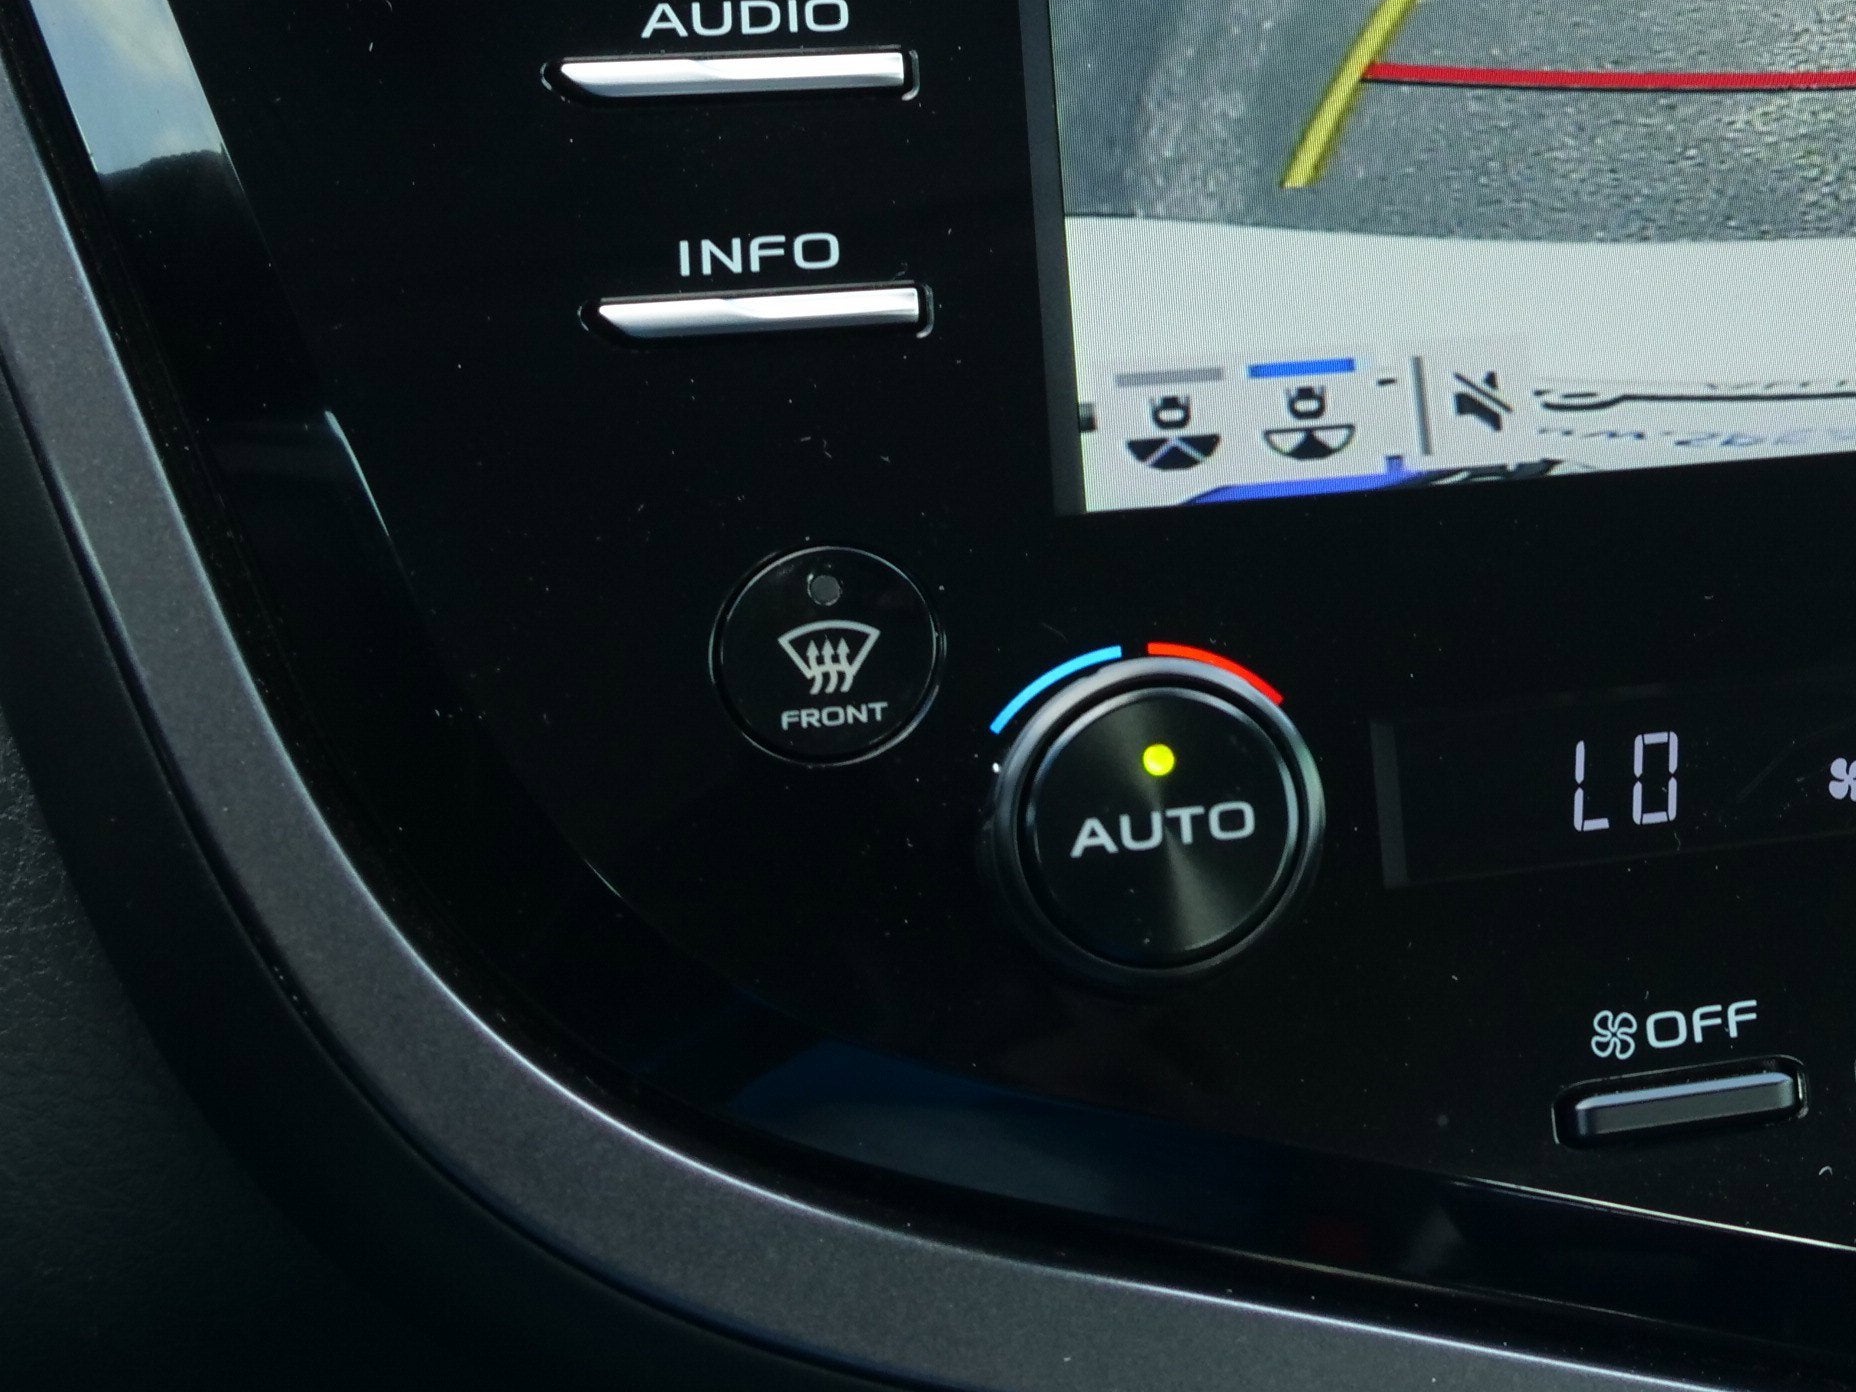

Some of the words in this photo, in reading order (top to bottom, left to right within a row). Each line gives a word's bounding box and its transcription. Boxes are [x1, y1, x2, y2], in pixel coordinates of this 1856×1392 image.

[679, 232, 840, 277] INFO
[781, 701, 888, 730] FRONT
[1071, 801, 1255, 857] AUTO
[1645, 999, 1757, 1049] OFF
